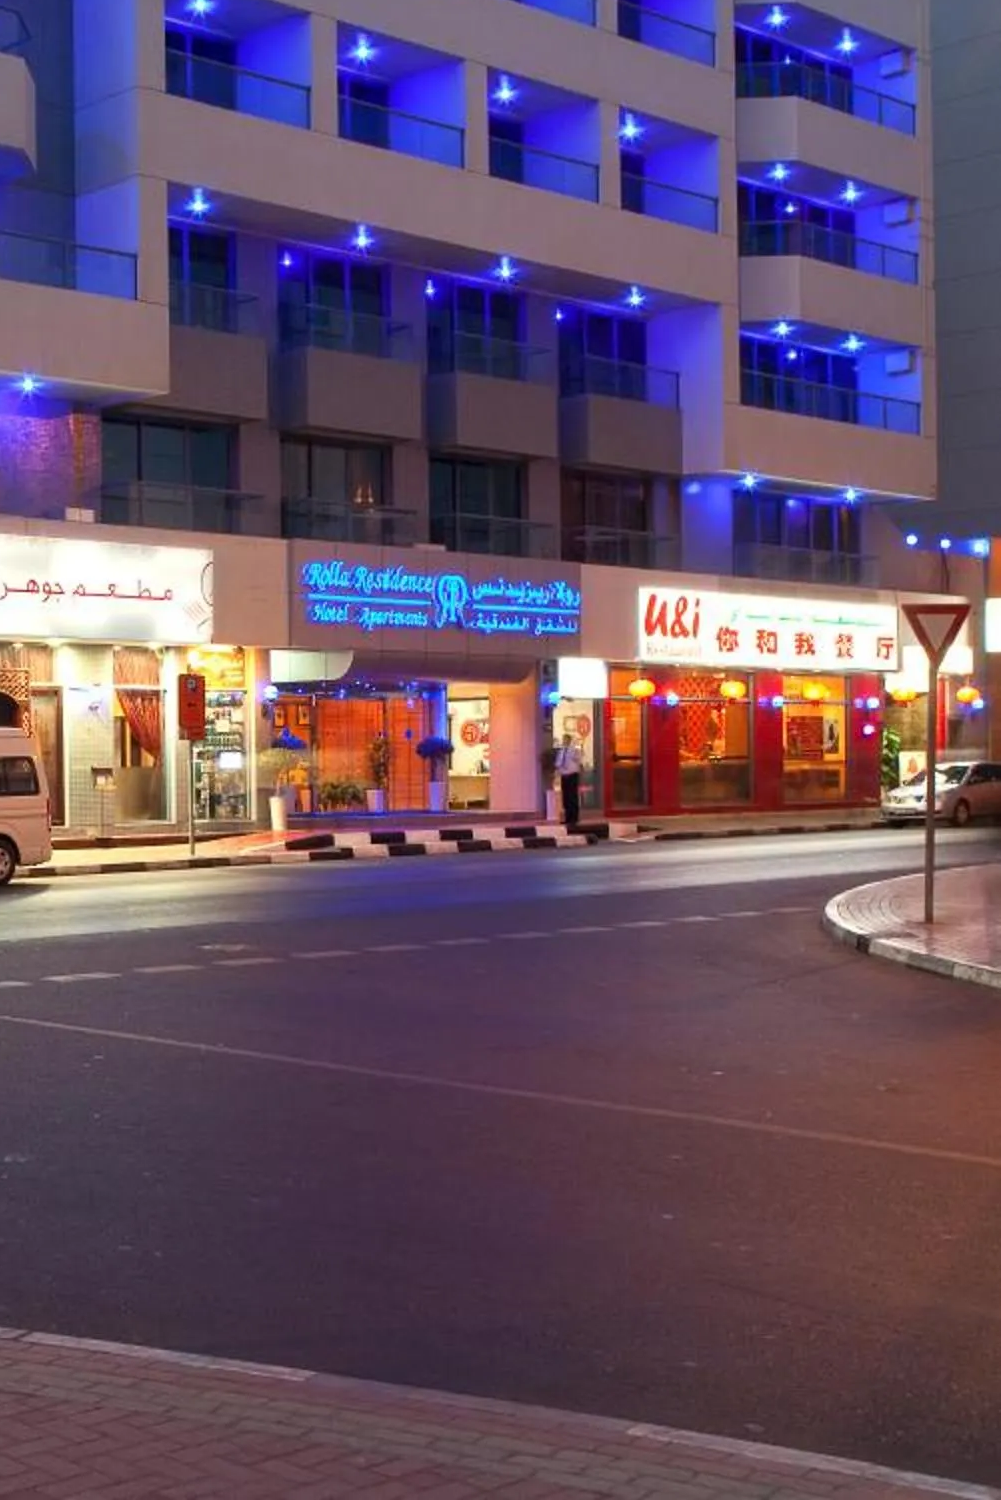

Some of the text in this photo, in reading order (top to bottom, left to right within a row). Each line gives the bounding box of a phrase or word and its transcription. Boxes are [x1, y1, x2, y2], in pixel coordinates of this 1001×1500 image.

[72, 579, 173, 601] مطعم
[302, 561, 433, 596] Rolla Residence
[310, 602, 428, 632] Hotel Apartments
